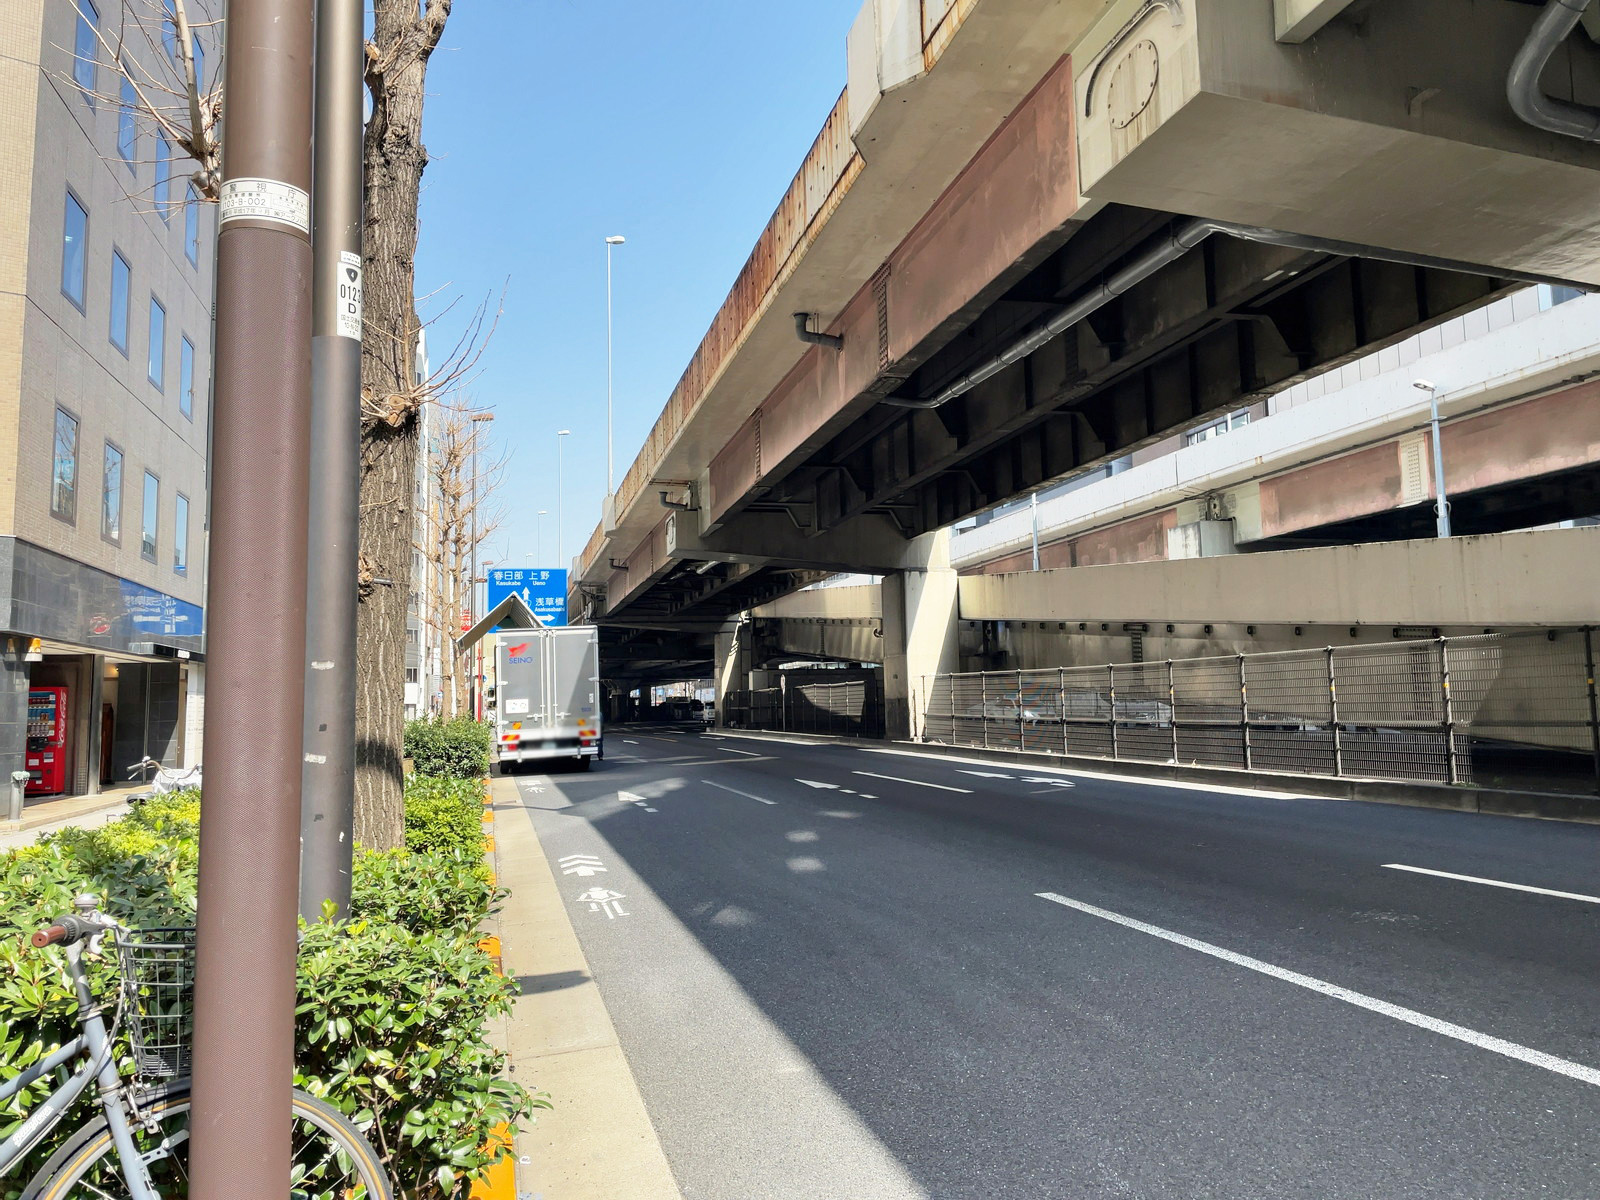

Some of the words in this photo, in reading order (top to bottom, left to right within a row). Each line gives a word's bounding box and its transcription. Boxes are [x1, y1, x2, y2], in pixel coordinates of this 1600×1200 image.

[229, 182, 297, 199] 警視庁
[348, 302, 356, 314] D
[493, 570, 524, 581] 春日部
[528, 570, 550, 581] 上野
[535, 597, 565, 606] 浅草橋
[508, 656, 533, 665] SEINO
